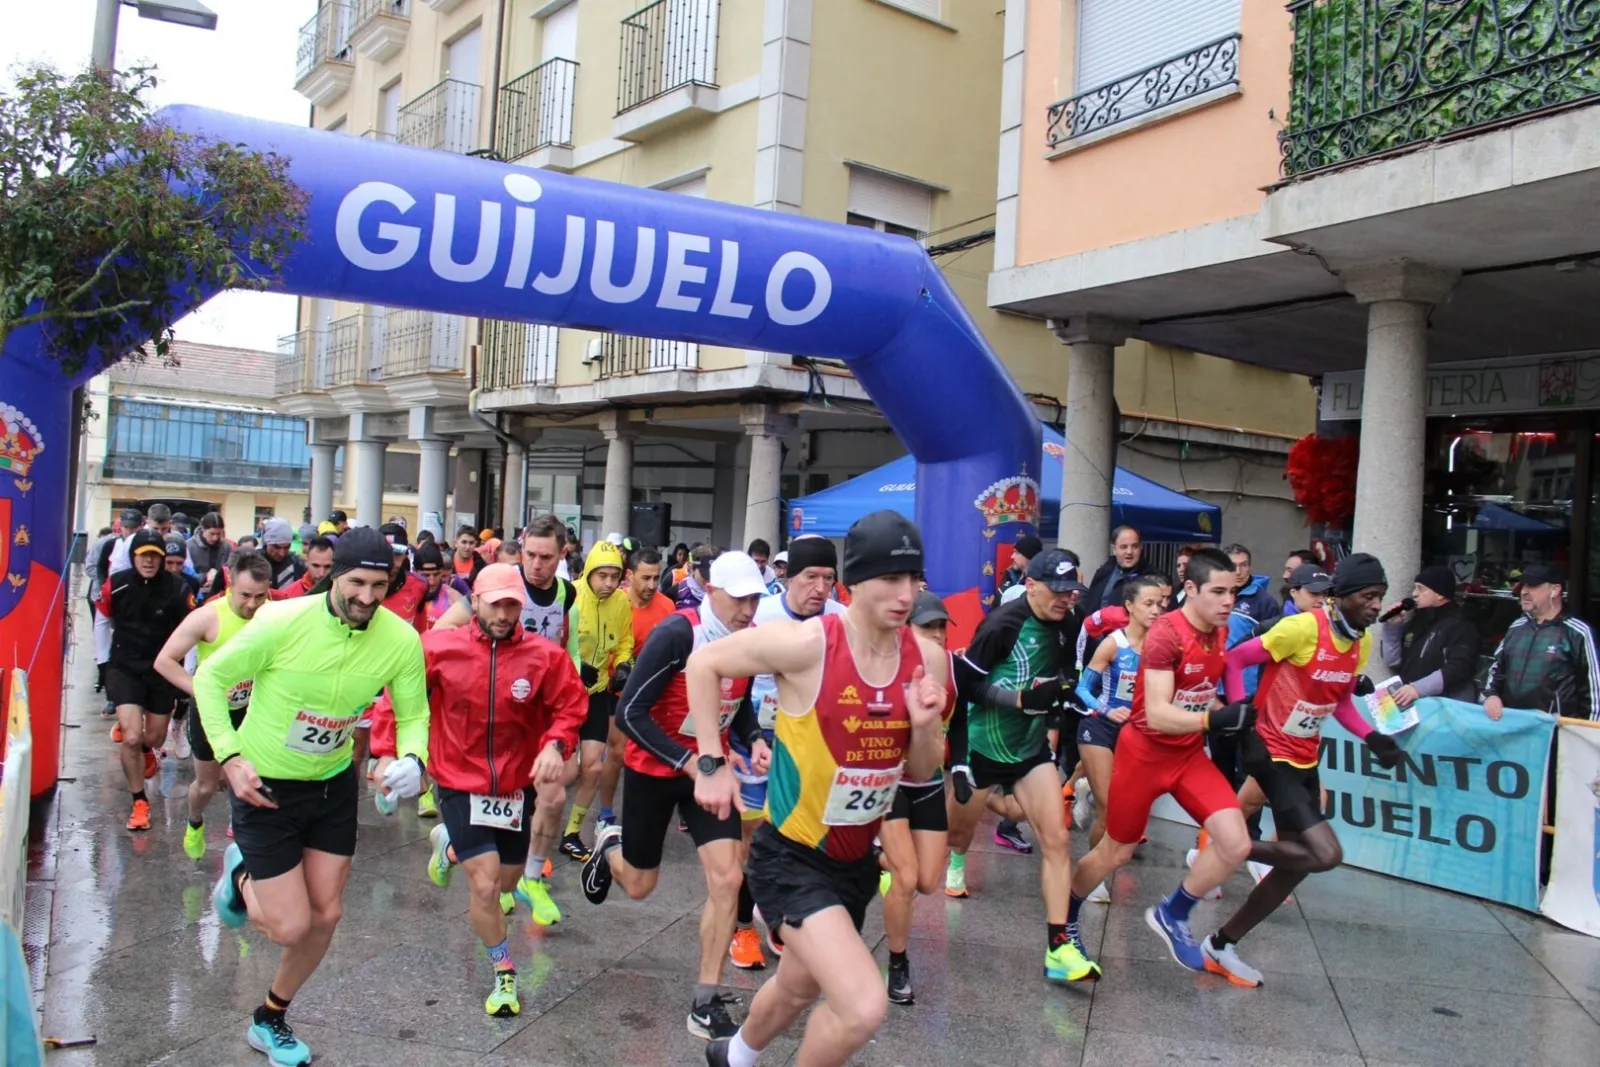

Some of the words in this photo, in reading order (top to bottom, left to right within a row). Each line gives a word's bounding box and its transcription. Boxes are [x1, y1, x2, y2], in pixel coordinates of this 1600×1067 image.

[302, 727, 343, 745] 261
[860, 737, 894, 748] VINO
[846, 751, 865, 762] DE
[867, 748, 901, 760] TORO
[481, 799, 513, 817] 266
